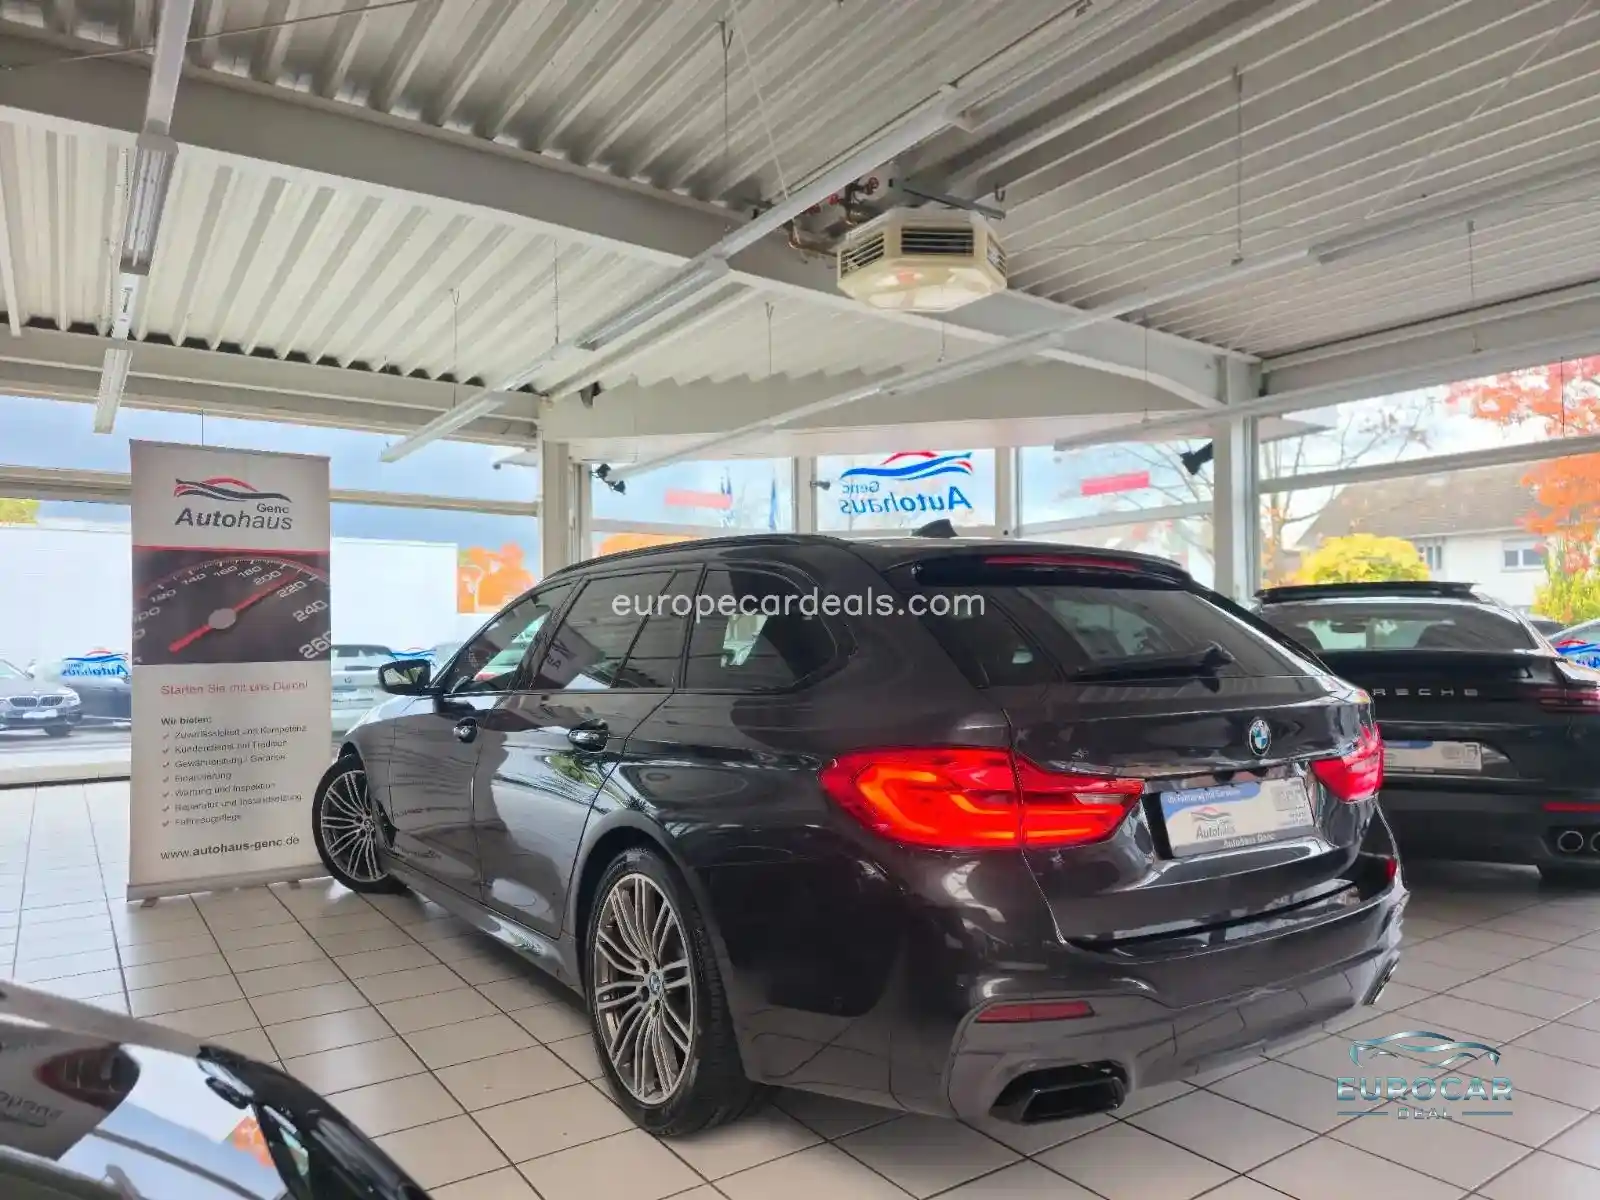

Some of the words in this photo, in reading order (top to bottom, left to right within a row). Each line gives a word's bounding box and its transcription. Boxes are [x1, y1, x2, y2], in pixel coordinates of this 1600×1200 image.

[256, 503, 290, 514] Genc
[174, 507, 293, 530] Autohaus
[253, 570, 282, 585] 200
[277, 580, 307, 598] 220
[292, 600, 329, 622] 240
[160, 684, 204, 696] Starten
[207, 683, 226, 694] Sie
[1373, 688, 1478, 697] RSCHE
[160, 717, 176, 726] Wir
[180, 716, 212, 725] bieten:
[160, 834, 300, 860] www.autohaus-genc.de
